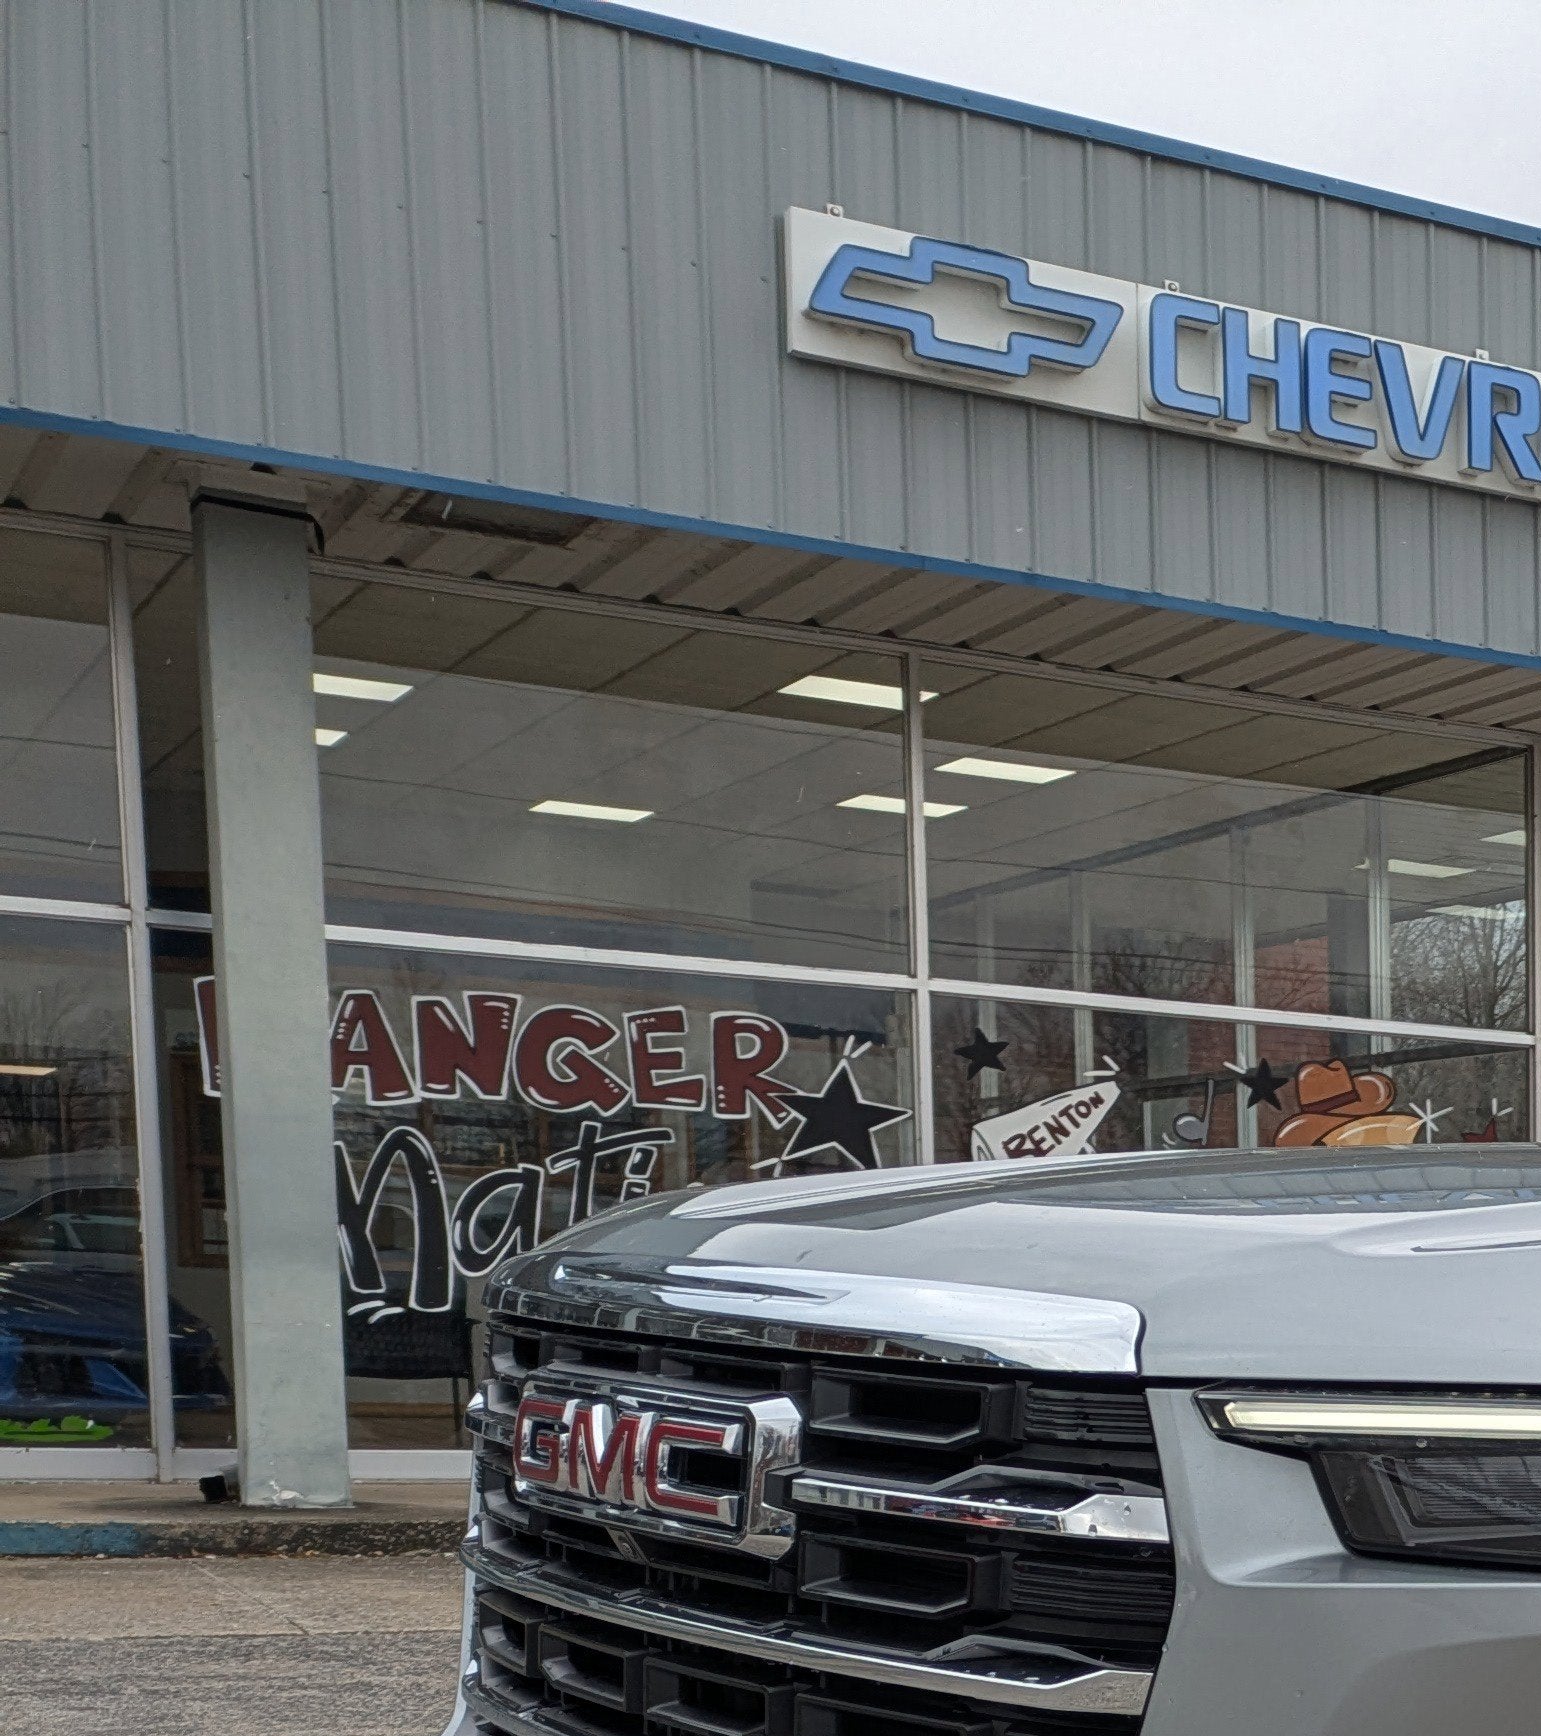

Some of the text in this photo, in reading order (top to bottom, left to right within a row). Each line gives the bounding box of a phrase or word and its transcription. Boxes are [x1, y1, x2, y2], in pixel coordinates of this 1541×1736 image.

[193, 974, 807, 1129] ANGER
[1001, 1090, 1105, 1158] BENTON
[513, 1398, 745, 1528] GMC
